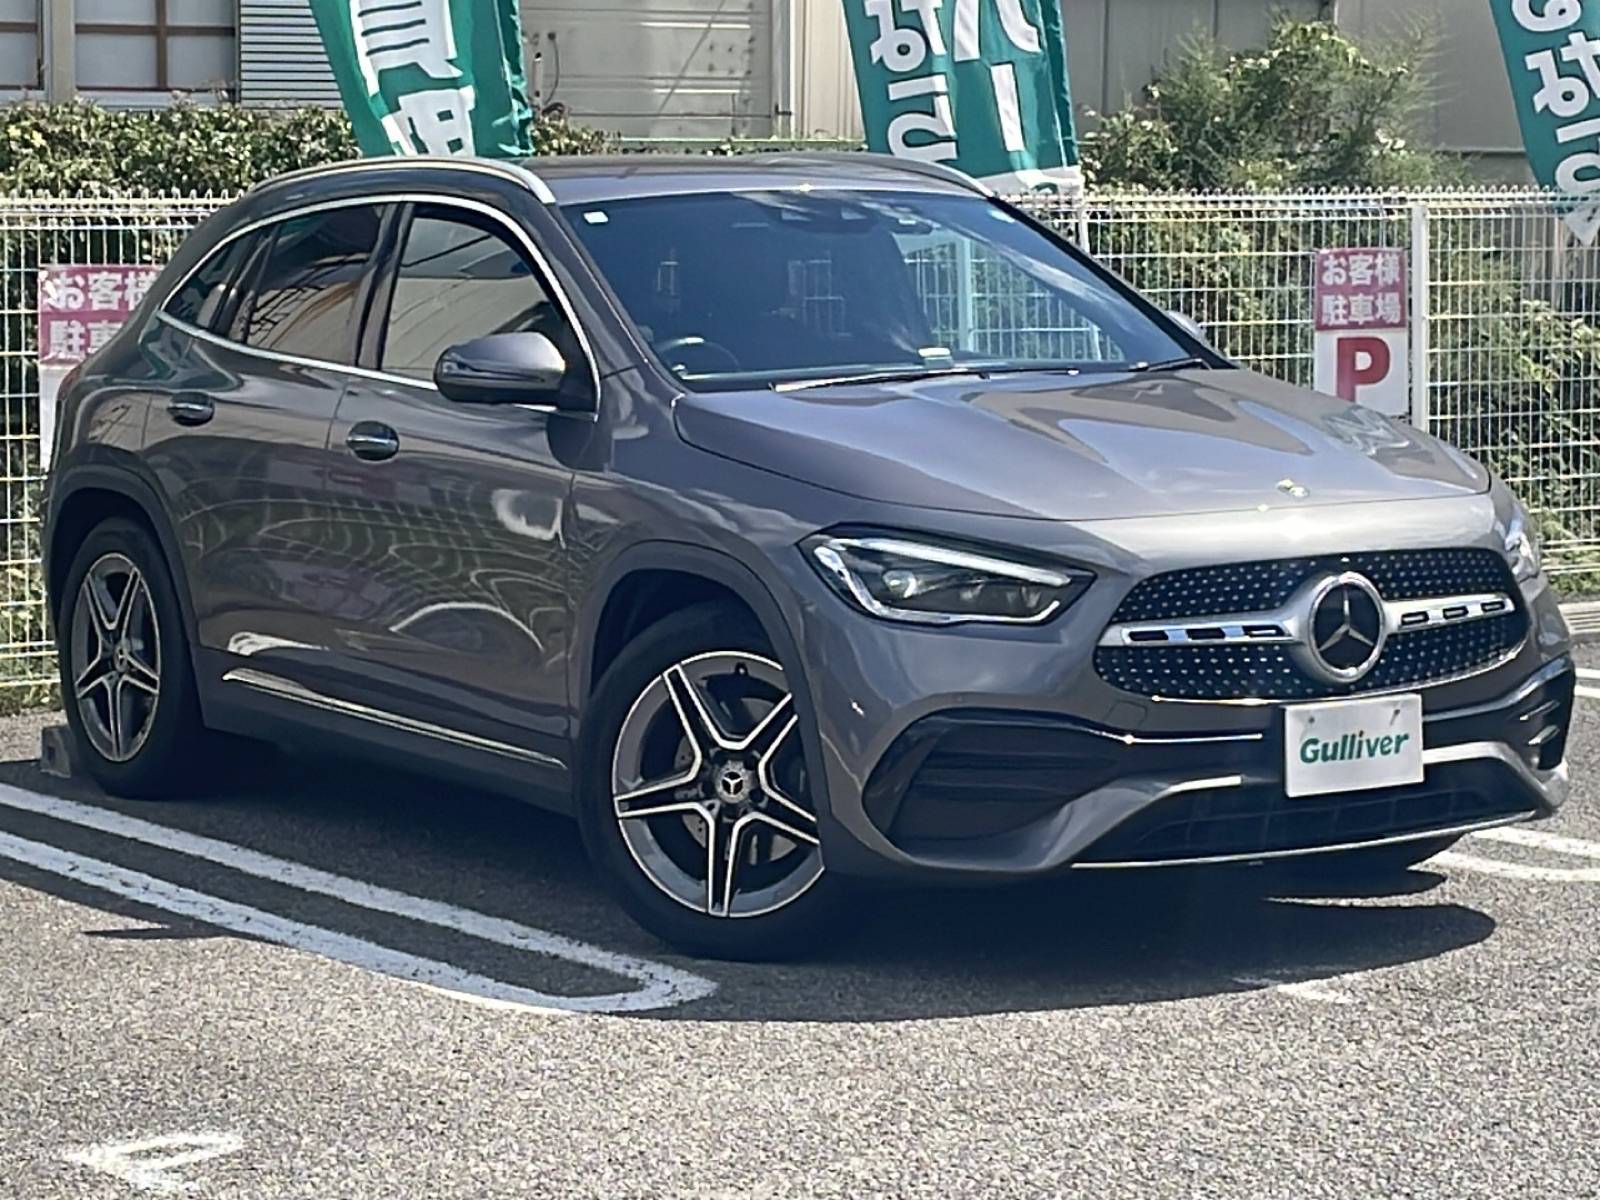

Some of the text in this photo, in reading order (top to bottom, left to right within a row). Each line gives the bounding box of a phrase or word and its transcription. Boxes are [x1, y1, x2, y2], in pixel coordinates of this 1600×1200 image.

[1321, 253, 1401, 287] お客様
[1321, 292, 1401, 326] 駐車場
[1337, 337, 1391, 402] P
[1300, 730, 1410, 764] Gulliver
